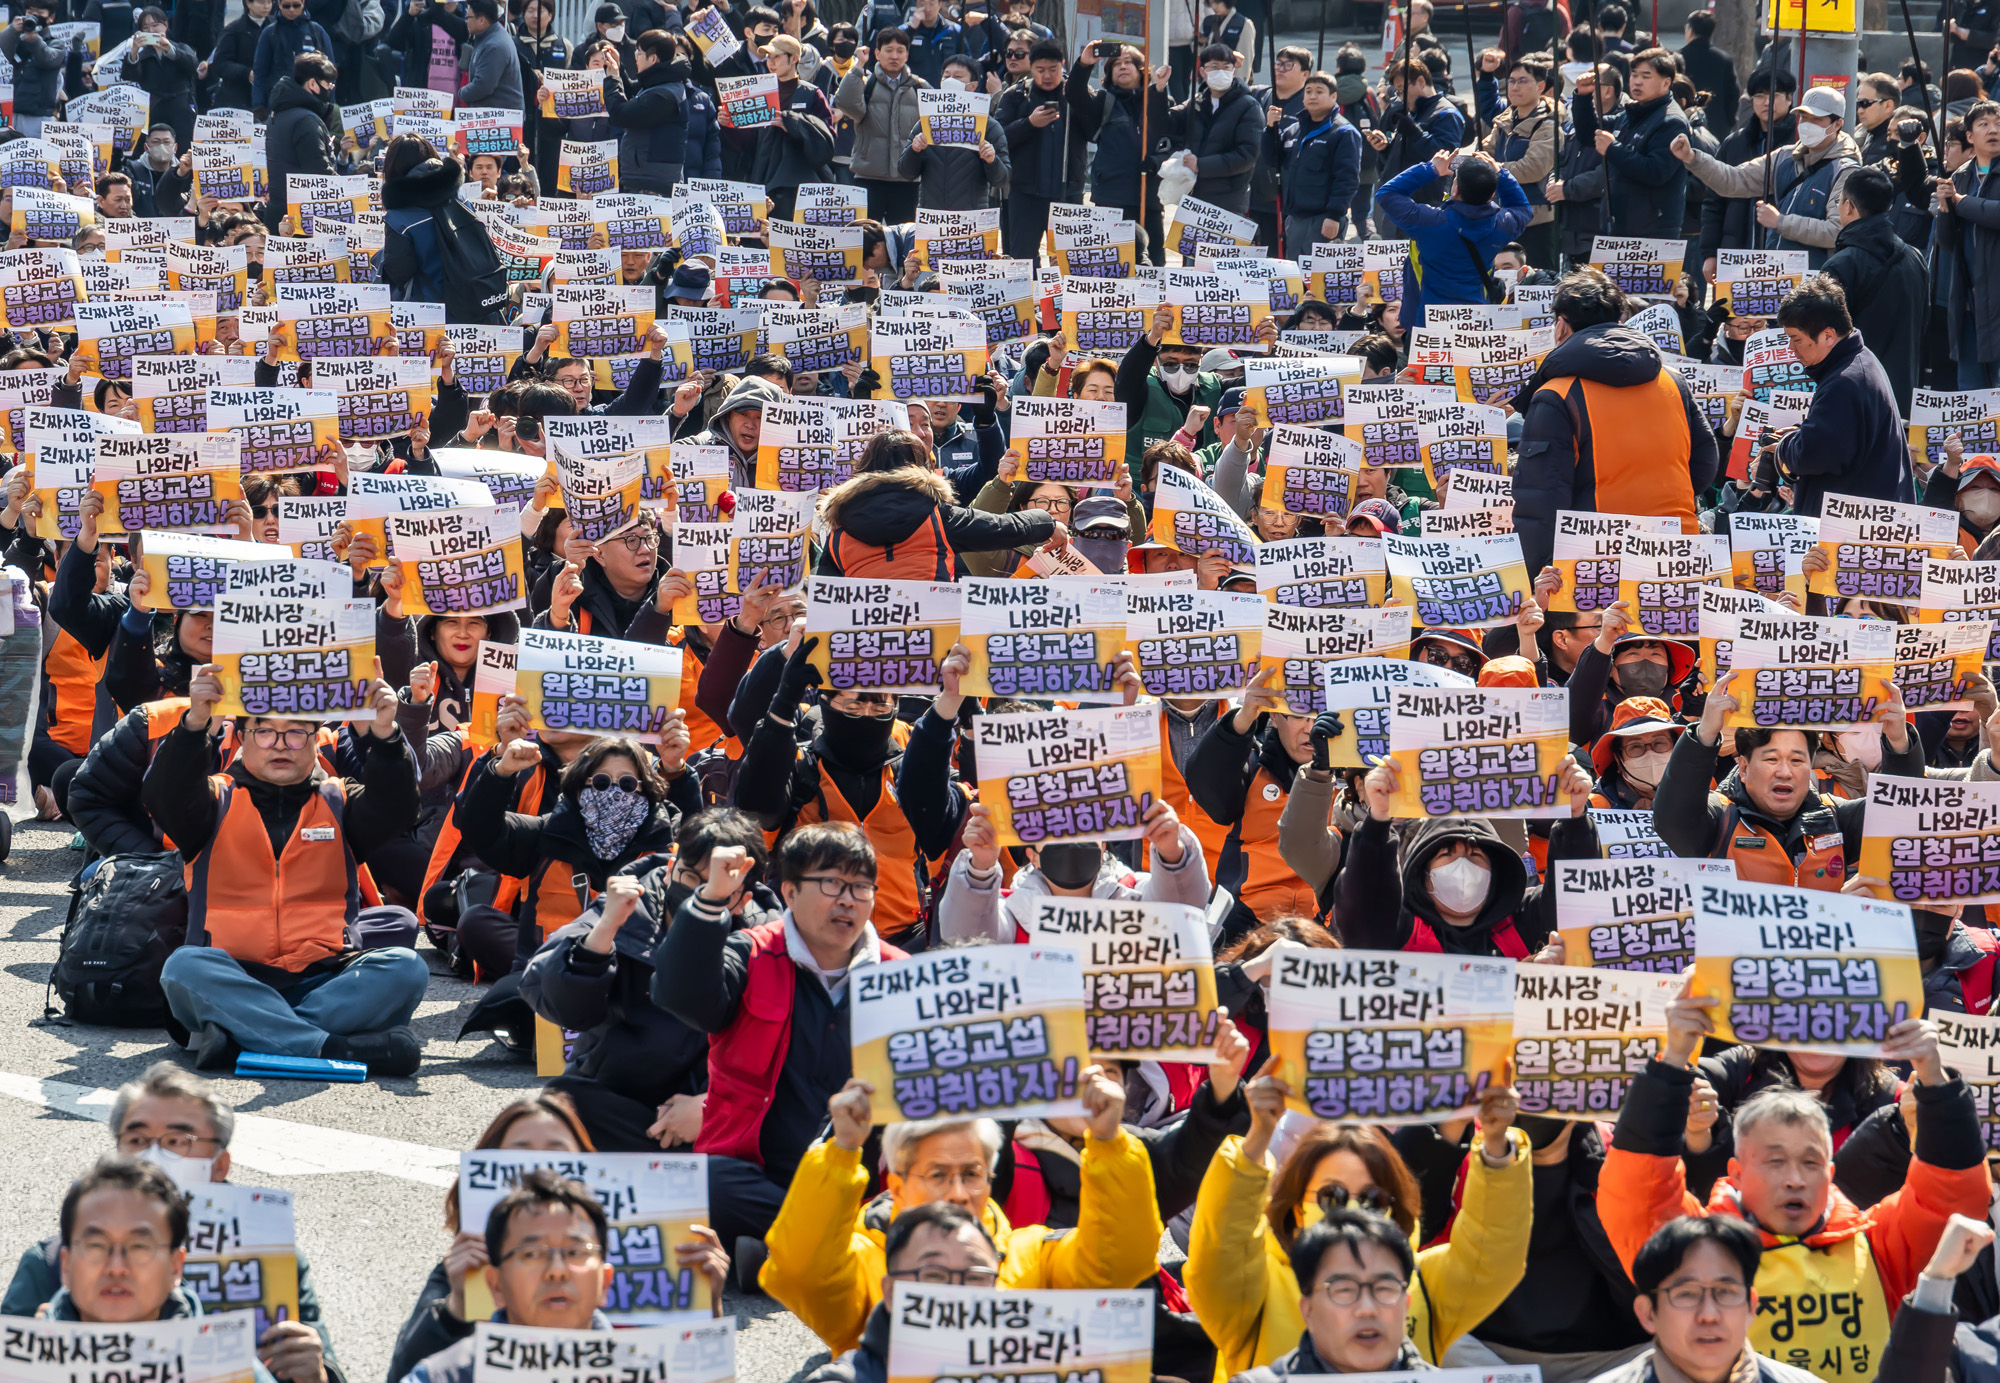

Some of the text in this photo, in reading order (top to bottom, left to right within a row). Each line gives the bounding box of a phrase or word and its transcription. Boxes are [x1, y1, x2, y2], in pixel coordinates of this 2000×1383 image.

[554, 89, 600, 104] 원청교섭
[929, 116, 976, 129] 원청교섭
[466, 140, 518, 153] 쟁취하자!
[931, 130, 980, 143] 쟁취하자!
[198, 169, 241, 182] 원청교섭
[24, 211, 79, 225] 원청교섭
[300, 203, 354, 219] 원청교섭
[805, 209, 855, 222] 원청교섭
[107, 221, 152, 234] 진짜사장
[607, 218, 660, 233] 원청교섭
[609, 233, 669, 247] 쟁취하자!
[1595, 238, 1642, 252] 진짜사장
[1066, 248, 1118, 264] 원청교섭
[1069, 262, 1128, 278] 쟁취하자!
[1170, 274, 1219, 288] 진짜사장
[1604, 264, 1663, 277] 원청교섭
[1745, 264, 1784, 278] 나와라!
[281, 286, 334, 300] 진짜사장
[556, 288, 606, 301] 진짜사장
[1067, 281, 1116, 294] 진짜사장
[1196, 288, 1240, 303] 나와라!
[1731, 281, 1793, 298] 원청교섭
[310, 296, 359, 317] 나와라!
[582, 300, 626, 316] 나와라!
[1092, 294, 1135, 309] 나와라!
[1077, 311, 1142, 330] 원청교섭
[1182, 307, 1248, 323] 원청교섭
[295, 318, 370, 338] 원청교섭
[569, 319, 634, 338] 원청교섭
[875, 321, 931, 335] 진짜사장
[569, 336, 646, 356] 쟁취하자!
[905, 334, 954, 352] 나와라!
[137, 358, 196, 376] 진짜사장
[891, 355, 963, 374] 원청교섭
[168, 374, 220, 393] 나와라!
[891, 376, 976, 396] 쟁취하자!
[1016, 402, 1074, 417] 진짜사장
[1418, 407, 1465, 424] 진짜사장
[1046, 418, 1095, 434] 나와라!
[1439, 420, 1484, 436] 나와라!
[100, 438, 171, 460] 진짜사장
[1027, 439, 1103, 459] 원청교섭
[1276, 429, 1333, 452] 진짜사장
[1430, 441, 1491, 460] 원청교섭
[136, 450, 199, 474] 나와라!
[1026, 461, 1113, 482] 쟁취하자!
[1304, 451, 1346, 470] 나와라!
[117, 474, 212, 504] 원청교섭
[1284, 467, 1349, 495] 원청교섭
[119, 501, 229, 530] 쟁취하자!
[1827, 499, 1896, 522] 진짜사장
[394, 516, 462, 537] 진짜사장
[1860, 523, 1920, 542] 나와라!
[430, 527, 492, 555] 나와라!
[1386, 538, 1449, 557] 진짜사장
[1260, 542, 1324, 565] 진짜사장
[1836, 545, 1929, 570] 원청교섭
[418, 549, 505, 585] 원청교섭
[1293, 555, 1354, 580] 나와라!
[1423, 555, 1482, 577] 나와라!
[424, 574, 516, 613] 쟁취하자!
[813, 584, 890, 603] 진짜사장
[966, 582, 1050, 606] 진짜사장
[1276, 579, 1366, 608] 원청교섭
[1411, 572, 1500, 599] 원청교섭
[220, 601, 303, 624] 진짜사장
[853, 602, 920, 625] 나와라!
[1009, 604, 1080, 629] 나와라!
[1418, 592, 1519, 625] 쟁취하자!
[1158, 610, 1224, 634] 나와라!
[1268, 609, 1344, 633] 진짜사장
[1740, 618, 1819, 641] 진짜사장
[264, 623, 336, 647] 나와라!
[524, 634, 603, 654] 진짜사장
[830, 629, 931, 658] 원청교섭
[1307, 630, 1374, 655] 나와라!
[986, 632, 1096, 665] 원청교섭
[1139, 636, 1237, 666] 원청교섭
[1780, 640, 1847, 664] 나와라!
[240, 649, 349, 683] 원청교섭
[566, 656, 634, 673] 나와라!
[542, 673, 647, 699] 원청교섭
[988, 663, 1113, 694] 쟁취하자!
[1756, 669, 1859, 697] 원청교섭
[240, 680, 367, 714] 쟁취하자!
[1397, 694, 1486, 716] 진짜사장
[542, 702, 665, 732] 쟁취하자!
[1754, 699, 1874, 725] 쟁취하자!
[981, 717, 1069, 745] 진짜사장
[1444, 712, 1521, 741] 나와라!
[1028, 734, 1107, 767] 나와라!
[1419, 742, 1535, 779] 원청교섭
[1006, 763, 1127, 807] 원청교섭
[1421, 775, 1558, 815] 쟁취하자!
[1874, 782, 1965, 807] 진짜사장
[1919, 805, 1997, 831] 나와라!
[1564, 865, 1654, 892] 진짜사장
[1612, 883, 1693, 916] 나와라!
[1702, 887, 1807, 919] 진짜사장
[1040, 906, 1143, 934] 진짜사장
[1760, 921, 1856, 952] 나와라!
[1092, 934, 1179, 965] 나와라!
[860, 956, 970, 1001] 진짜사장
[1281, 955, 1400, 990] 진짜사장
[1731, 958, 1879, 999] 원청교섭
[916, 977, 1022, 1021] 나와라!
[1340, 987, 1444, 1021] 나와라!
[886, 1014, 1048, 1075] 원청교섭
[1304, 1027, 1466, 1074] 원청교섭
[894, 1056, 1078, 1120] 쟁취하자!
[1305, 1071, 1491, 1119] 쟁취하자!
[902, 1294, 1034, 1330] 진짜사장
[1756, 1293, 1863, 1342] 정의당
[5, 1325, 134, 1365] 진짜사장
[485, 1335, 616, 1370] 진짜사장
[968, 1326, 1082, 1366] 나와라!
